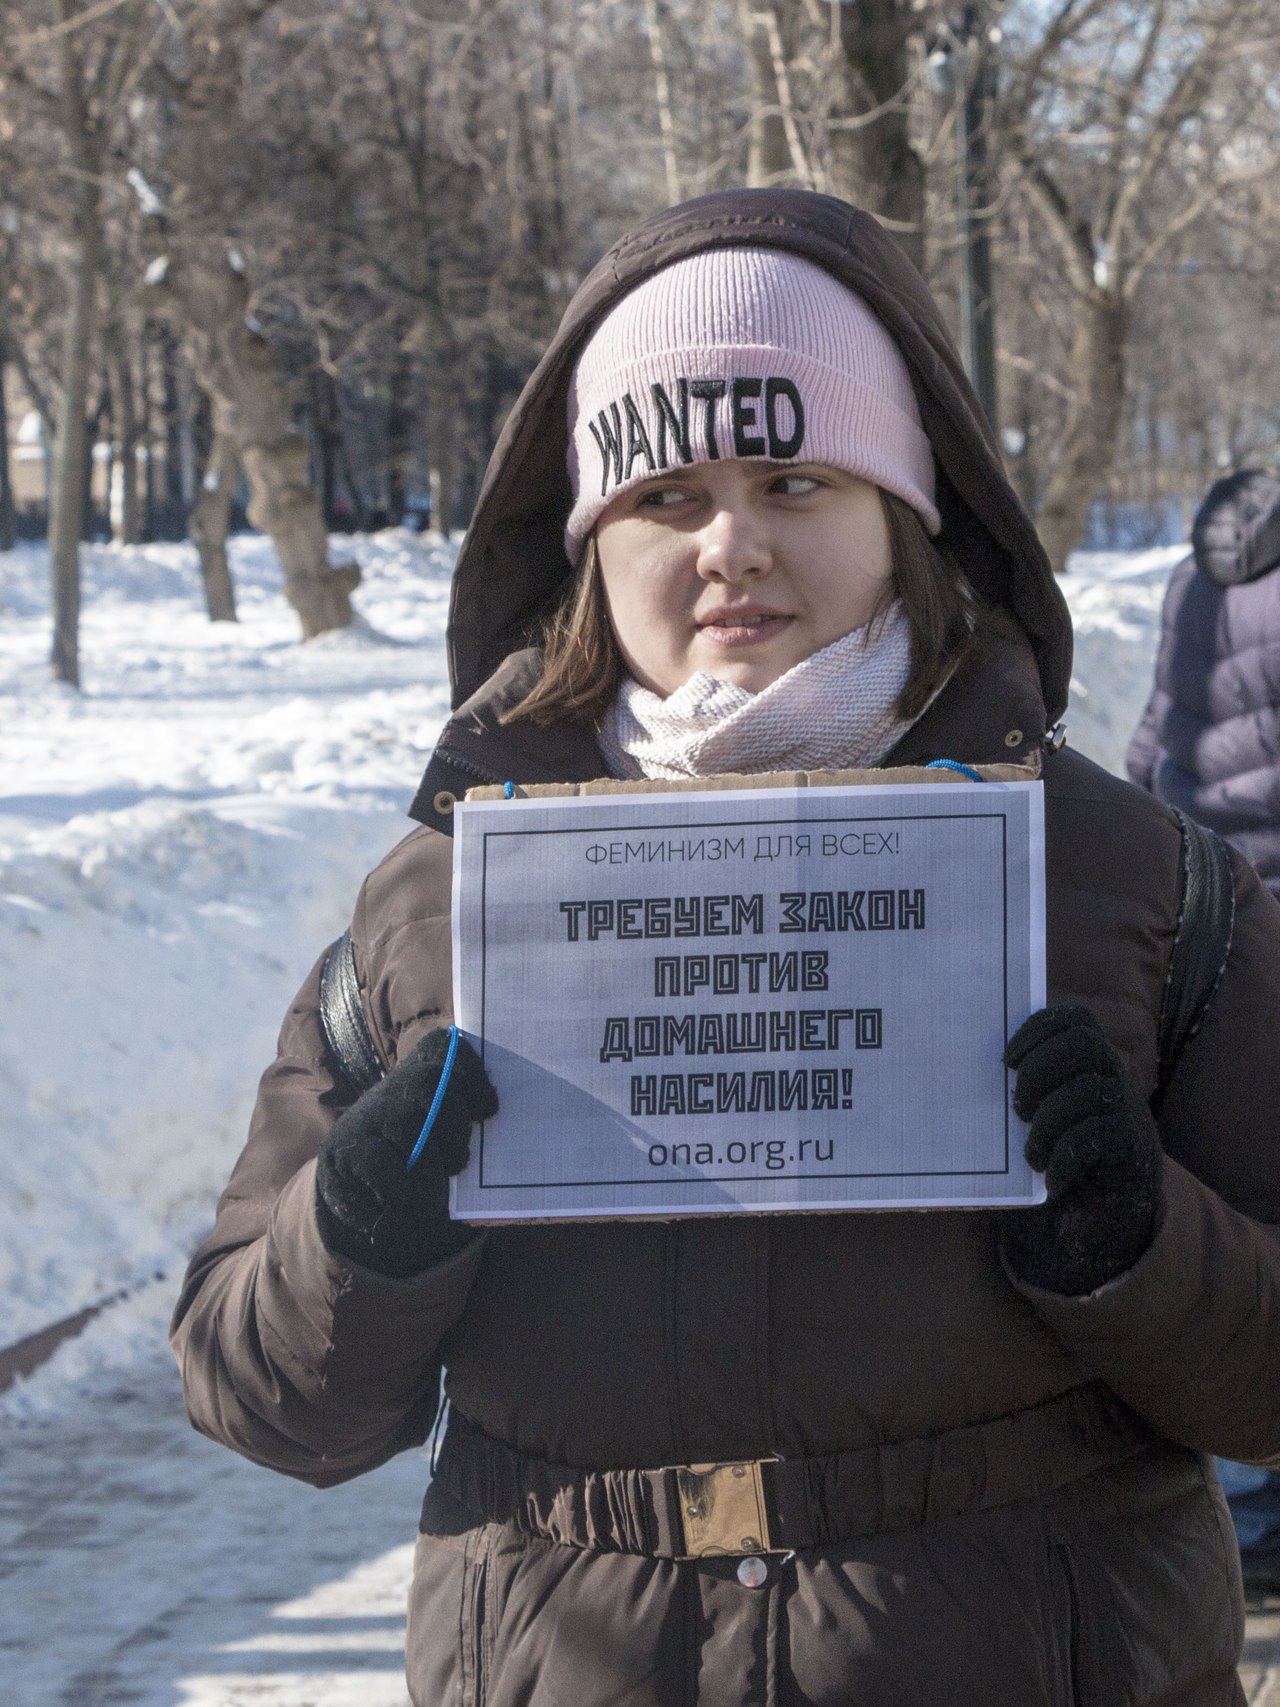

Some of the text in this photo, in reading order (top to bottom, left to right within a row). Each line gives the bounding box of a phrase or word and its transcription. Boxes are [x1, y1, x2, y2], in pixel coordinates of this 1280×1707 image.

[588, 377, 805, 496] WANTED
[585, 832, 901, 865] ФЕМИНИЗМ ДЛЯ ВСЕХ!
[560, 889, 925, 942] ТРЕБУЕМ ЗАКОН
[654, 950, 829, 997] ПРОТИВ
[600, 1008, 883, 1063] ДОМАШНЕГО
[630, 1068, 853, 1116] НАСИЛИЯ!
[648, 1136, 834, 1169] ona.org.ru
